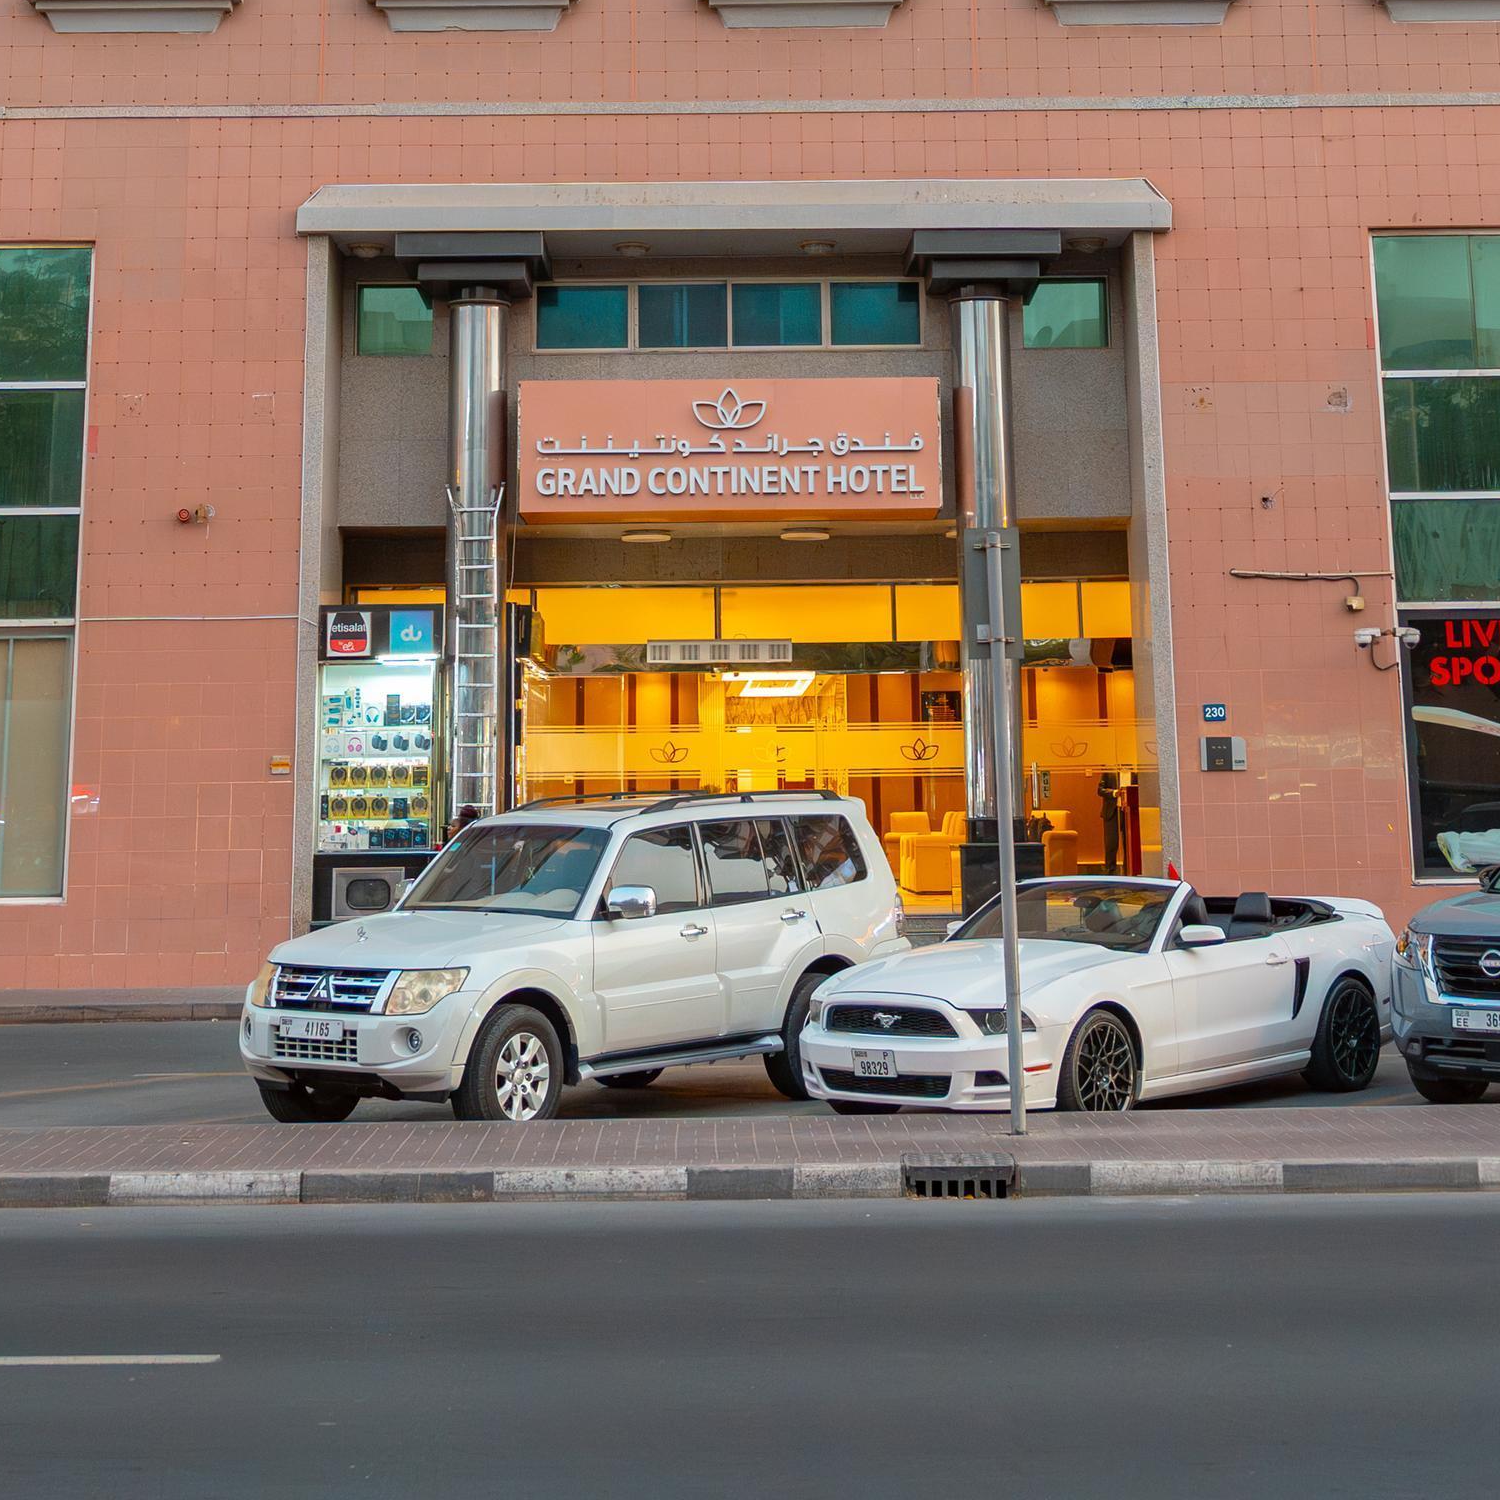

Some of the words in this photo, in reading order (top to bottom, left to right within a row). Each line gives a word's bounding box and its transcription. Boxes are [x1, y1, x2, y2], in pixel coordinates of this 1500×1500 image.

[536, 433, 727, 458] كونتيننت
[732, 433, 825, 457] جراند
[830, 432, 925, 456] فندق
[536, 466, 641, 496] GRAND
[647, 465, 821, 495] CONTINENT
[826, 464, 926, 493] HOTEL
[400, 624, 422, 642] du
[1205, 707, 1225, 718] 230
[305, 1021, 330, 1037] 41165
[1456, 1017, 1469, 1027] EE
[882, 1051, 889, 1060] P
[860, 1061, 889, 1076] 98329
